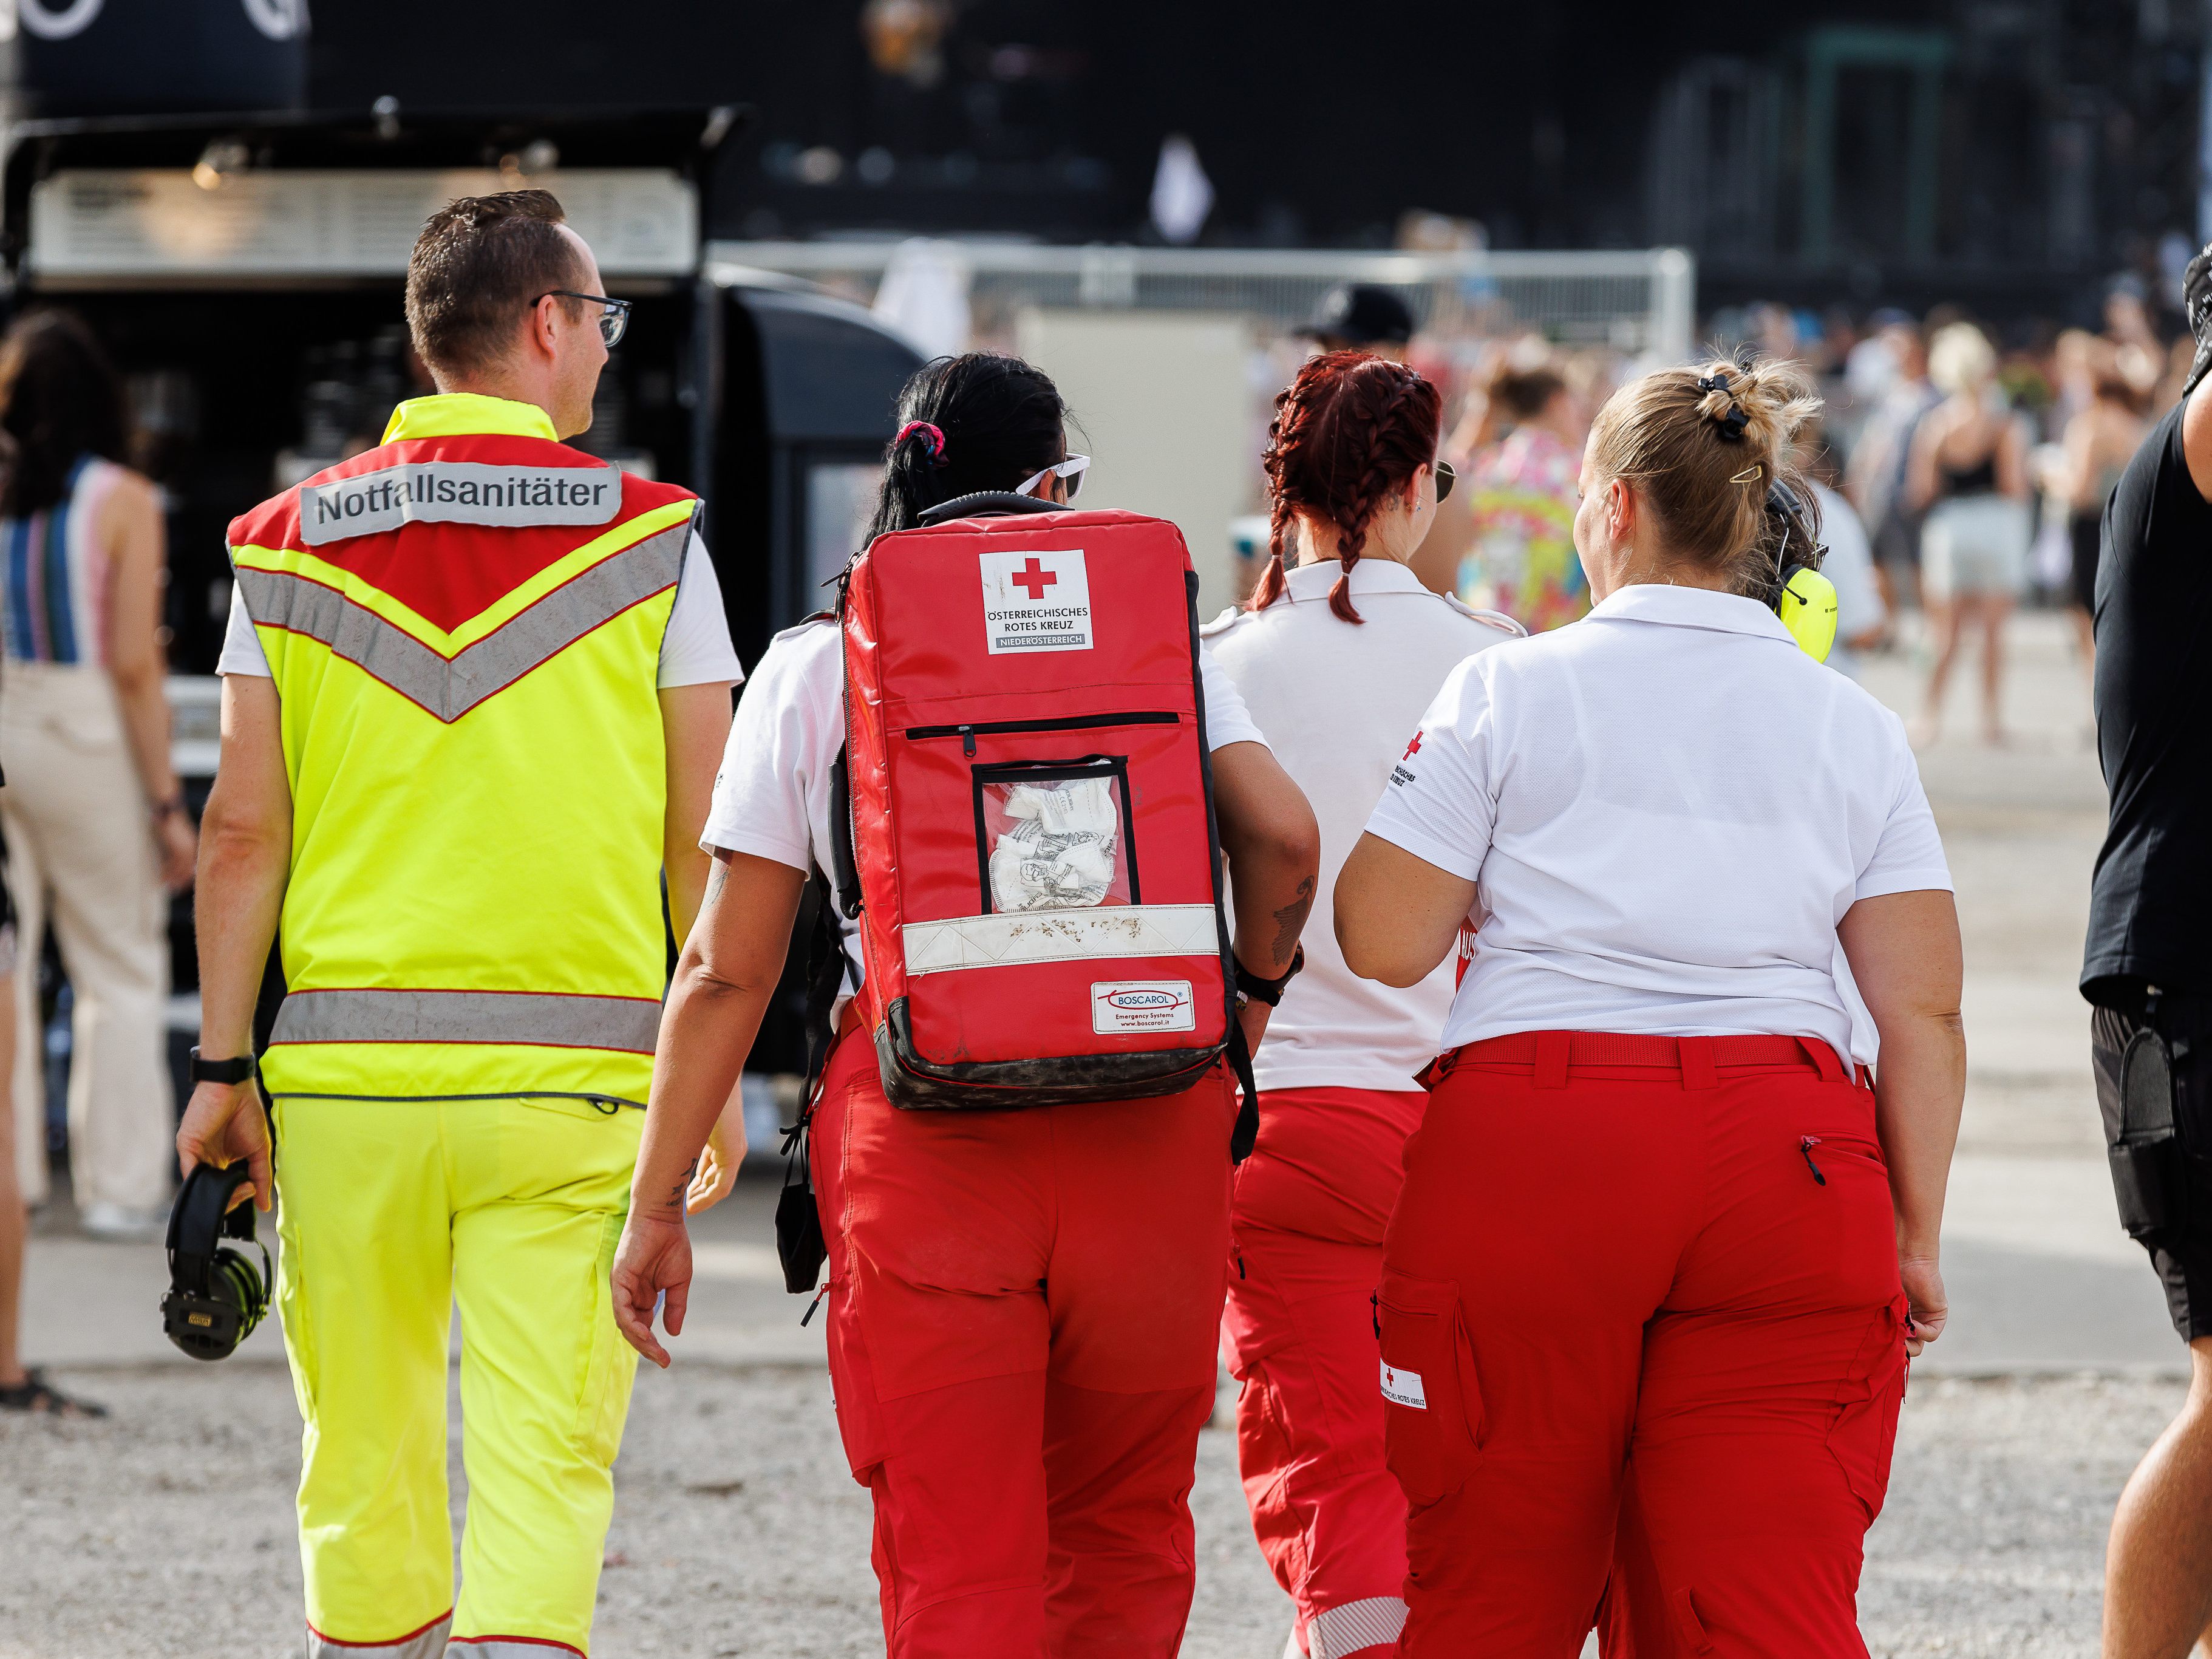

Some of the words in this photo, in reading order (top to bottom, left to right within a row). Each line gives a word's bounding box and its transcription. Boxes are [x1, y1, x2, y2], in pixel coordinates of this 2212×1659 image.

[318, 474, 608, 524] Notfallsanitäter
[987, 607, 1088, 621] ÖSTERREICHISCHES
[1005, 622, 1036, 632] ROTES
[1041, 621, 1074, 630] KREUZ
[1000, 635, 1082, 647] NIEDERÖSTERREICH
[1118, 995, 1169, 1005] BOSCAROL
[1410, 1397, 1425, 1406] KREUZ
